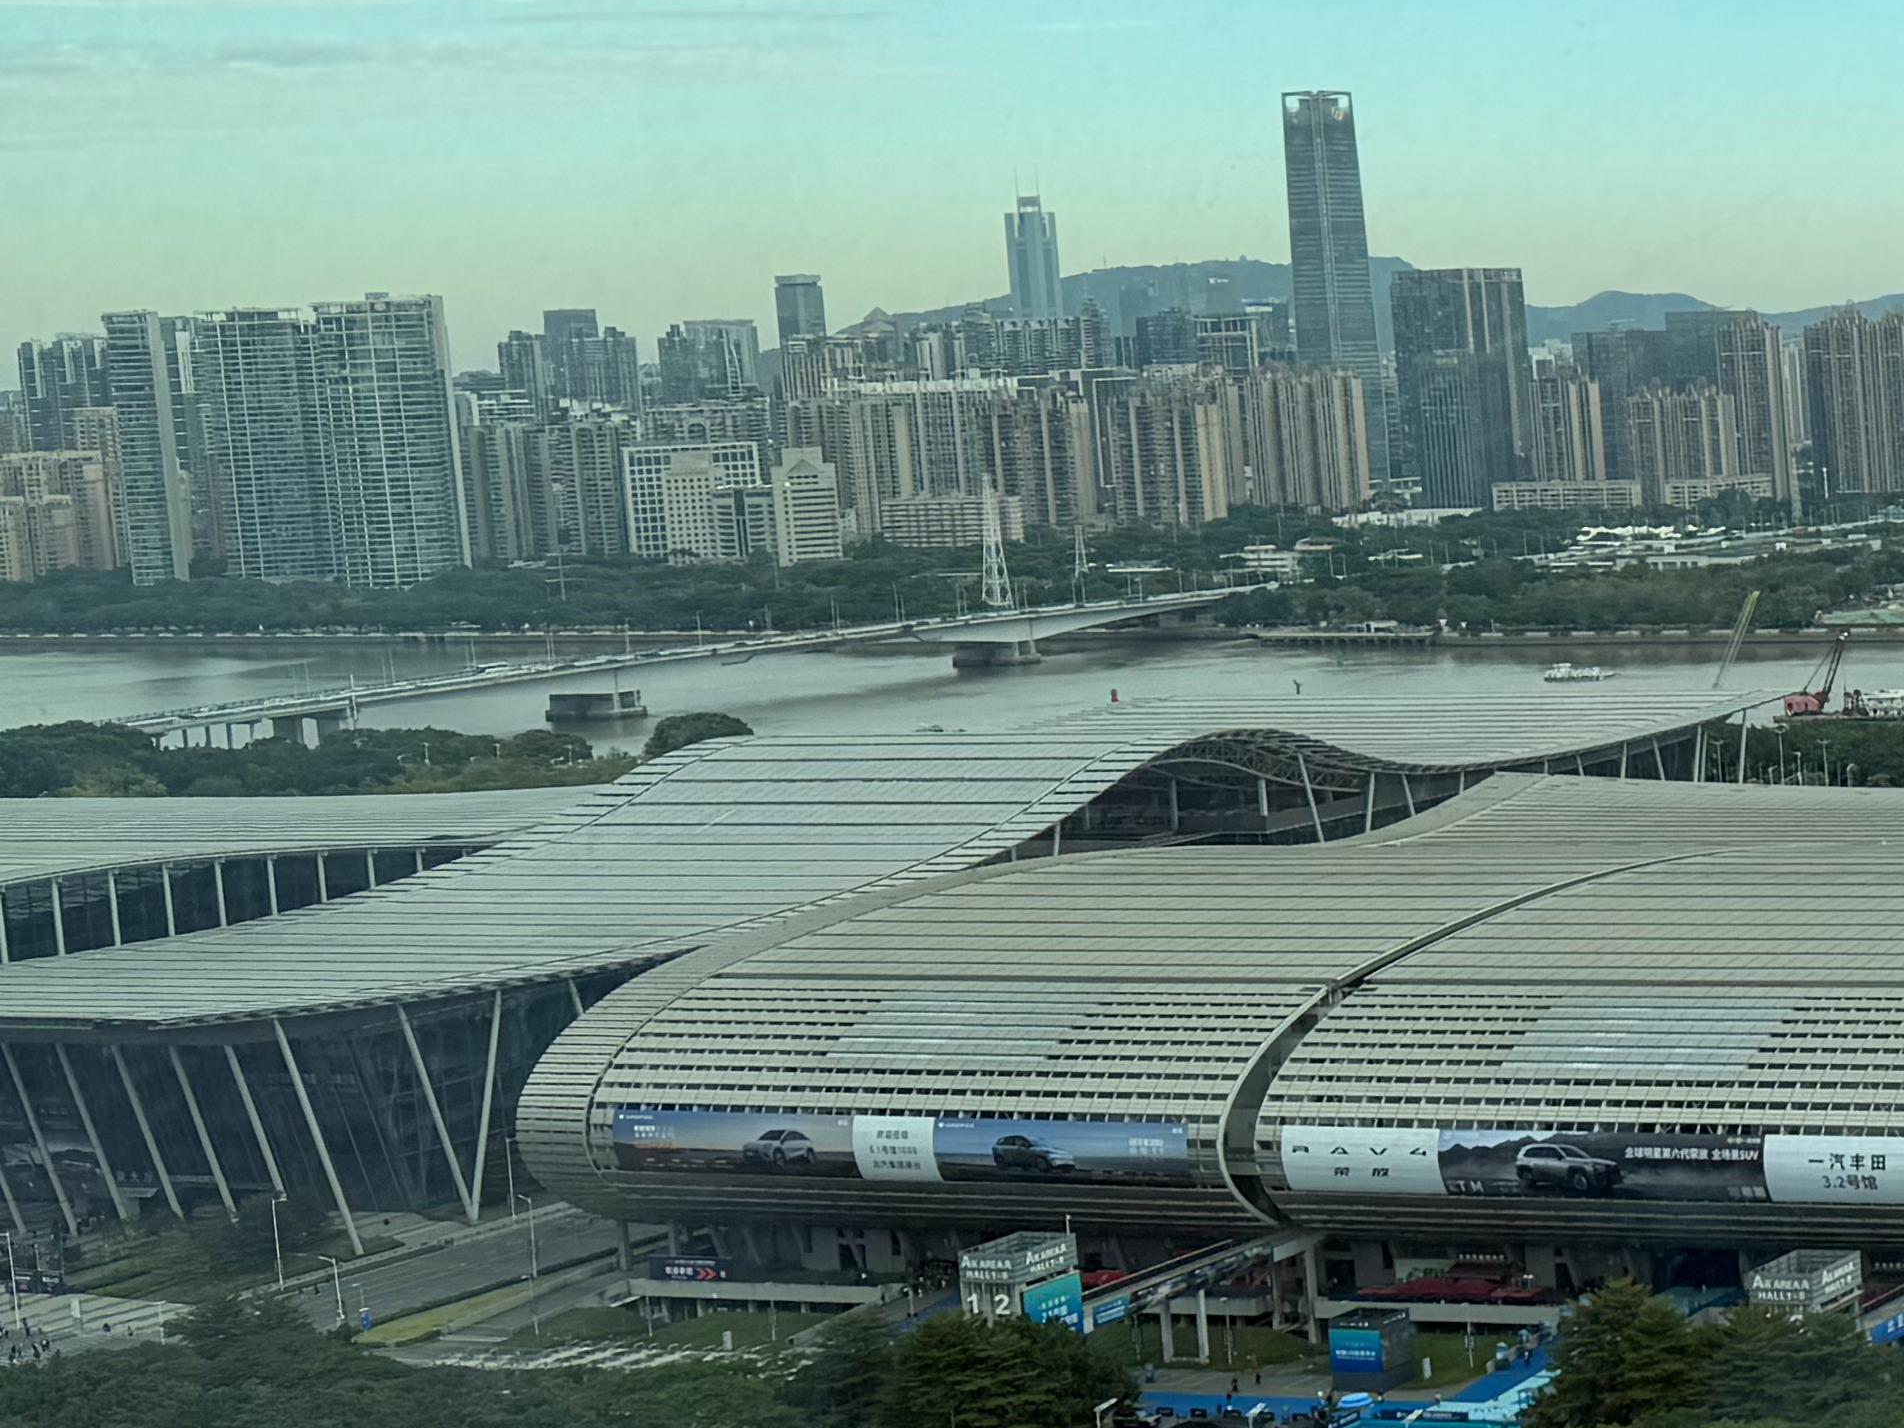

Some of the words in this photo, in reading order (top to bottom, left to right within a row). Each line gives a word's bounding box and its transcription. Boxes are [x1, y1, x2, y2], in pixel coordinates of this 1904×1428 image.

[1808, 1153, 1886, 1171] 一汽丰田
[1822, 1174, 1879, 1190] 3.2号馆
[967, 1293, 979, 1314] 1
[994, 1294, 1011, 1315] 2
